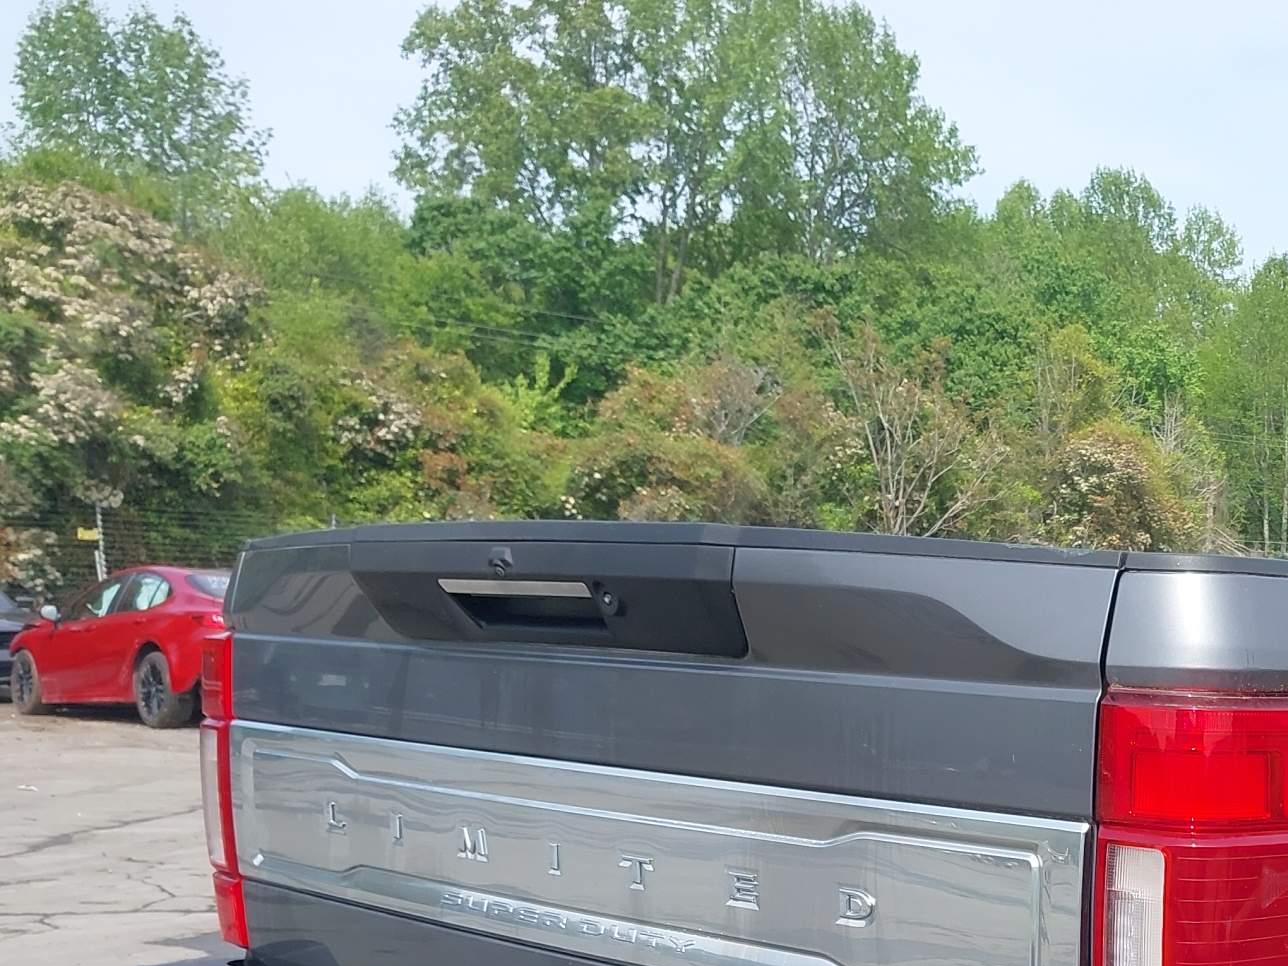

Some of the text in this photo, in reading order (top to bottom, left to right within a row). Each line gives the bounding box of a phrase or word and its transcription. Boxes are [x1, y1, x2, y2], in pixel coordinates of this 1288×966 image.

[325, 800, 877, 928] LIMITED
[440, 889, 695, 953] SUPER DUTY
